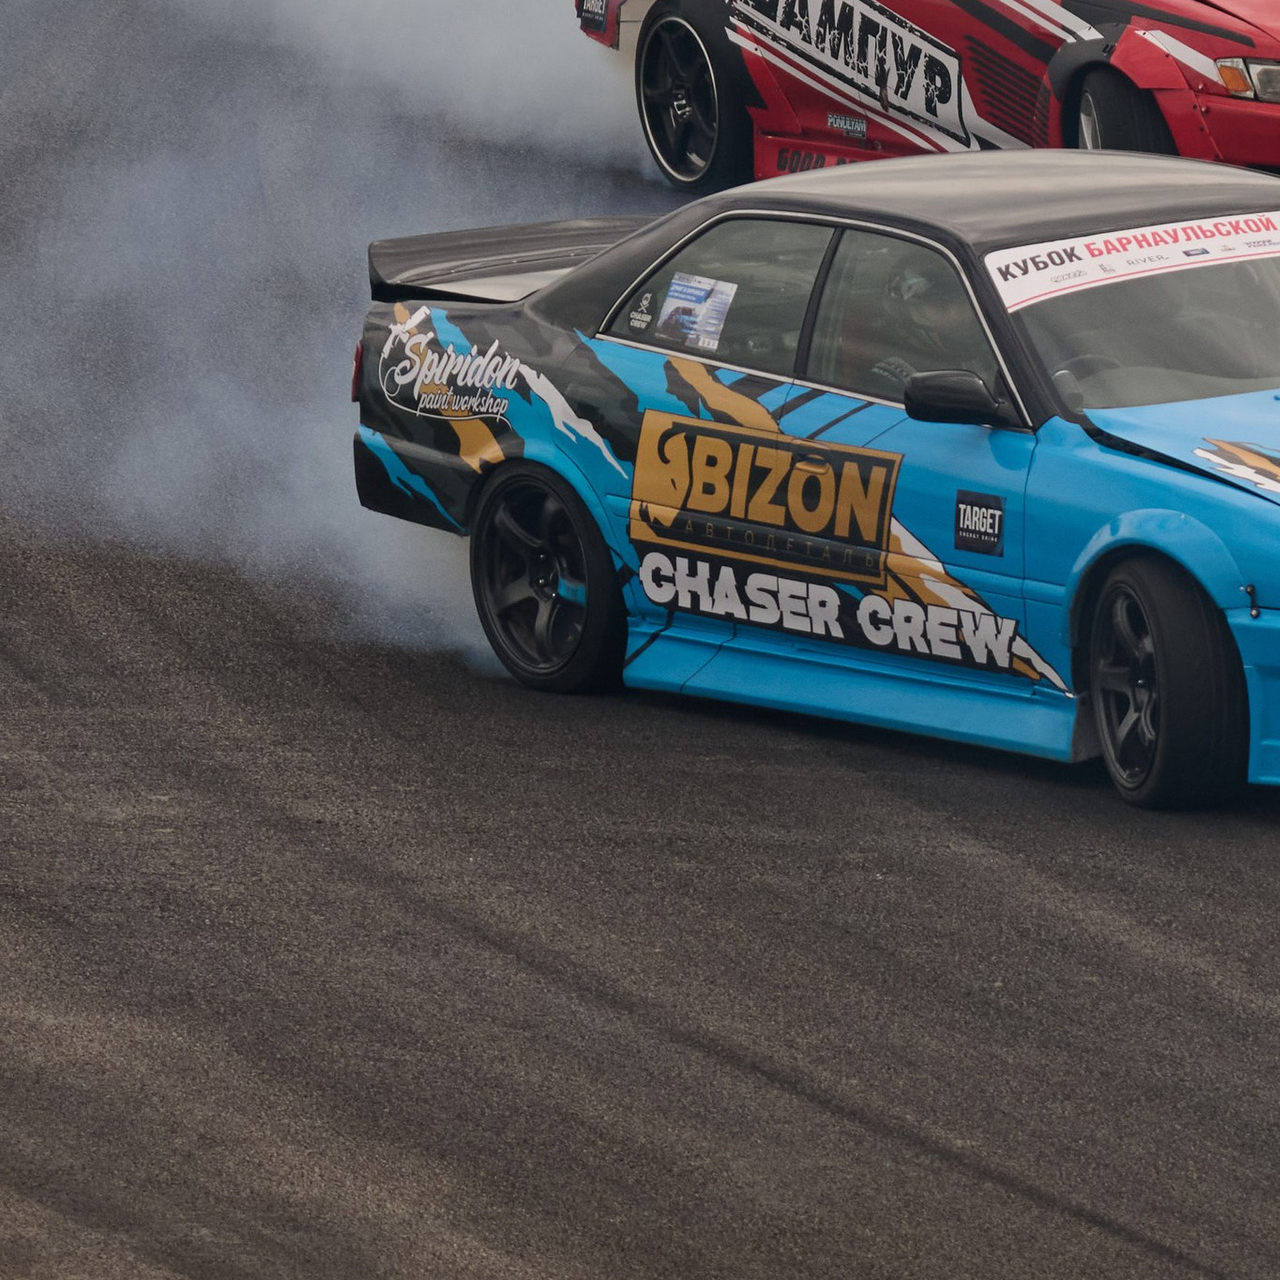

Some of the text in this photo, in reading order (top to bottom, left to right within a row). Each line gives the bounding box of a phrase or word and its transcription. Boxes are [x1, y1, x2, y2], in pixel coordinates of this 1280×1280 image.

[996, 246, 1084, 282] КУБОК
[1084, 215, 1277, 258] БАРНАУЛЬСКОЙ
[394, 331, 520, 400] Spiridon
[417, 386, 508, 422] paint workshop
[687, 435, 887, 543] BIZON
[958, 503, 1002, 534] TARGET
[639, 552, 1016, 668] CHASER CREW
